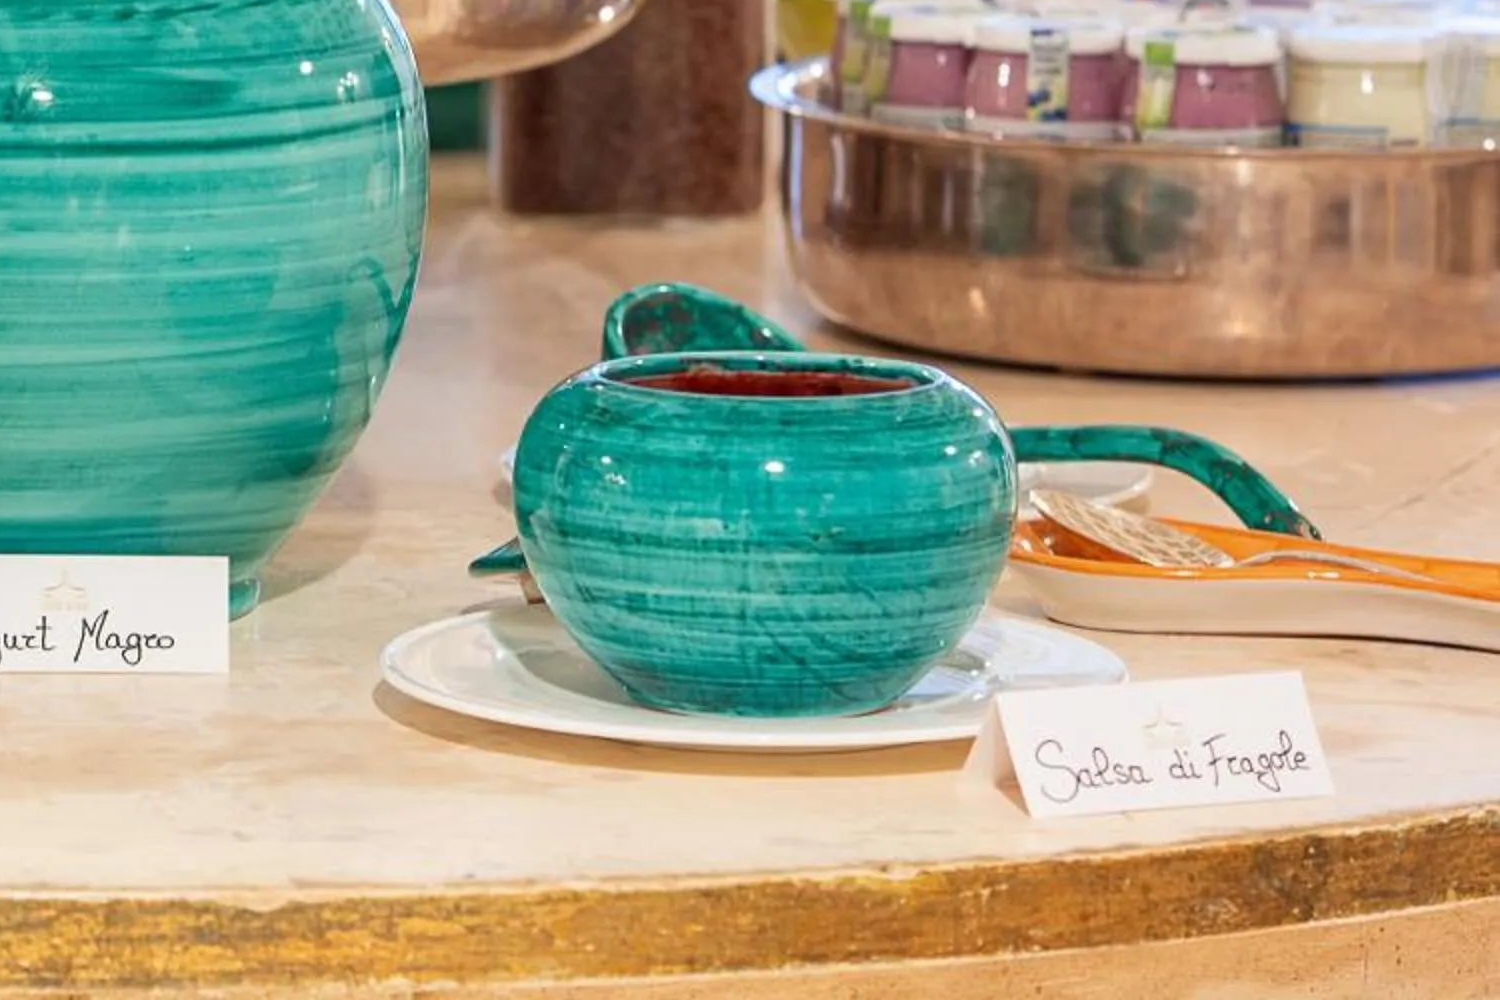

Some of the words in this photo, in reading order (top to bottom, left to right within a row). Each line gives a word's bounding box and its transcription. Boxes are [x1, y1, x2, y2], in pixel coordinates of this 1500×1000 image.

[72, 609, 176, 666] Magro
[1035, 738, 1151, 804] Salsa
[1169, 747, 1202, 781] di
[1201, 729, 1312, 794] Fragole
